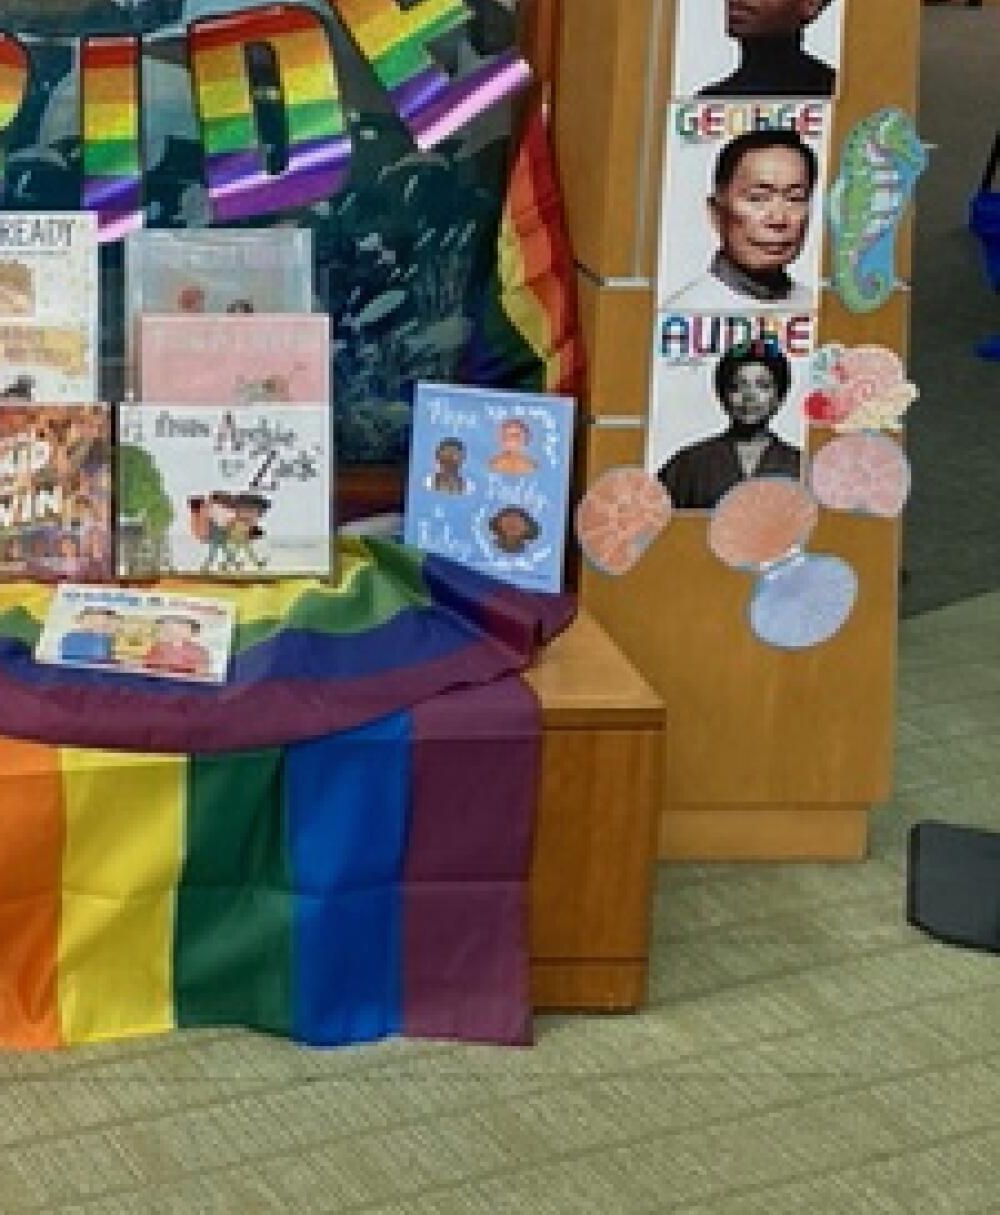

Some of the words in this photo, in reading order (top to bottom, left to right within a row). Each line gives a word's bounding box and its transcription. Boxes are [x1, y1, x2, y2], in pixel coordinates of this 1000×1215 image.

[675, 106, 824, 136] GEORGE
[0, 218, 75, 247] READY
[661, 315, 810, 358] AUDRE
